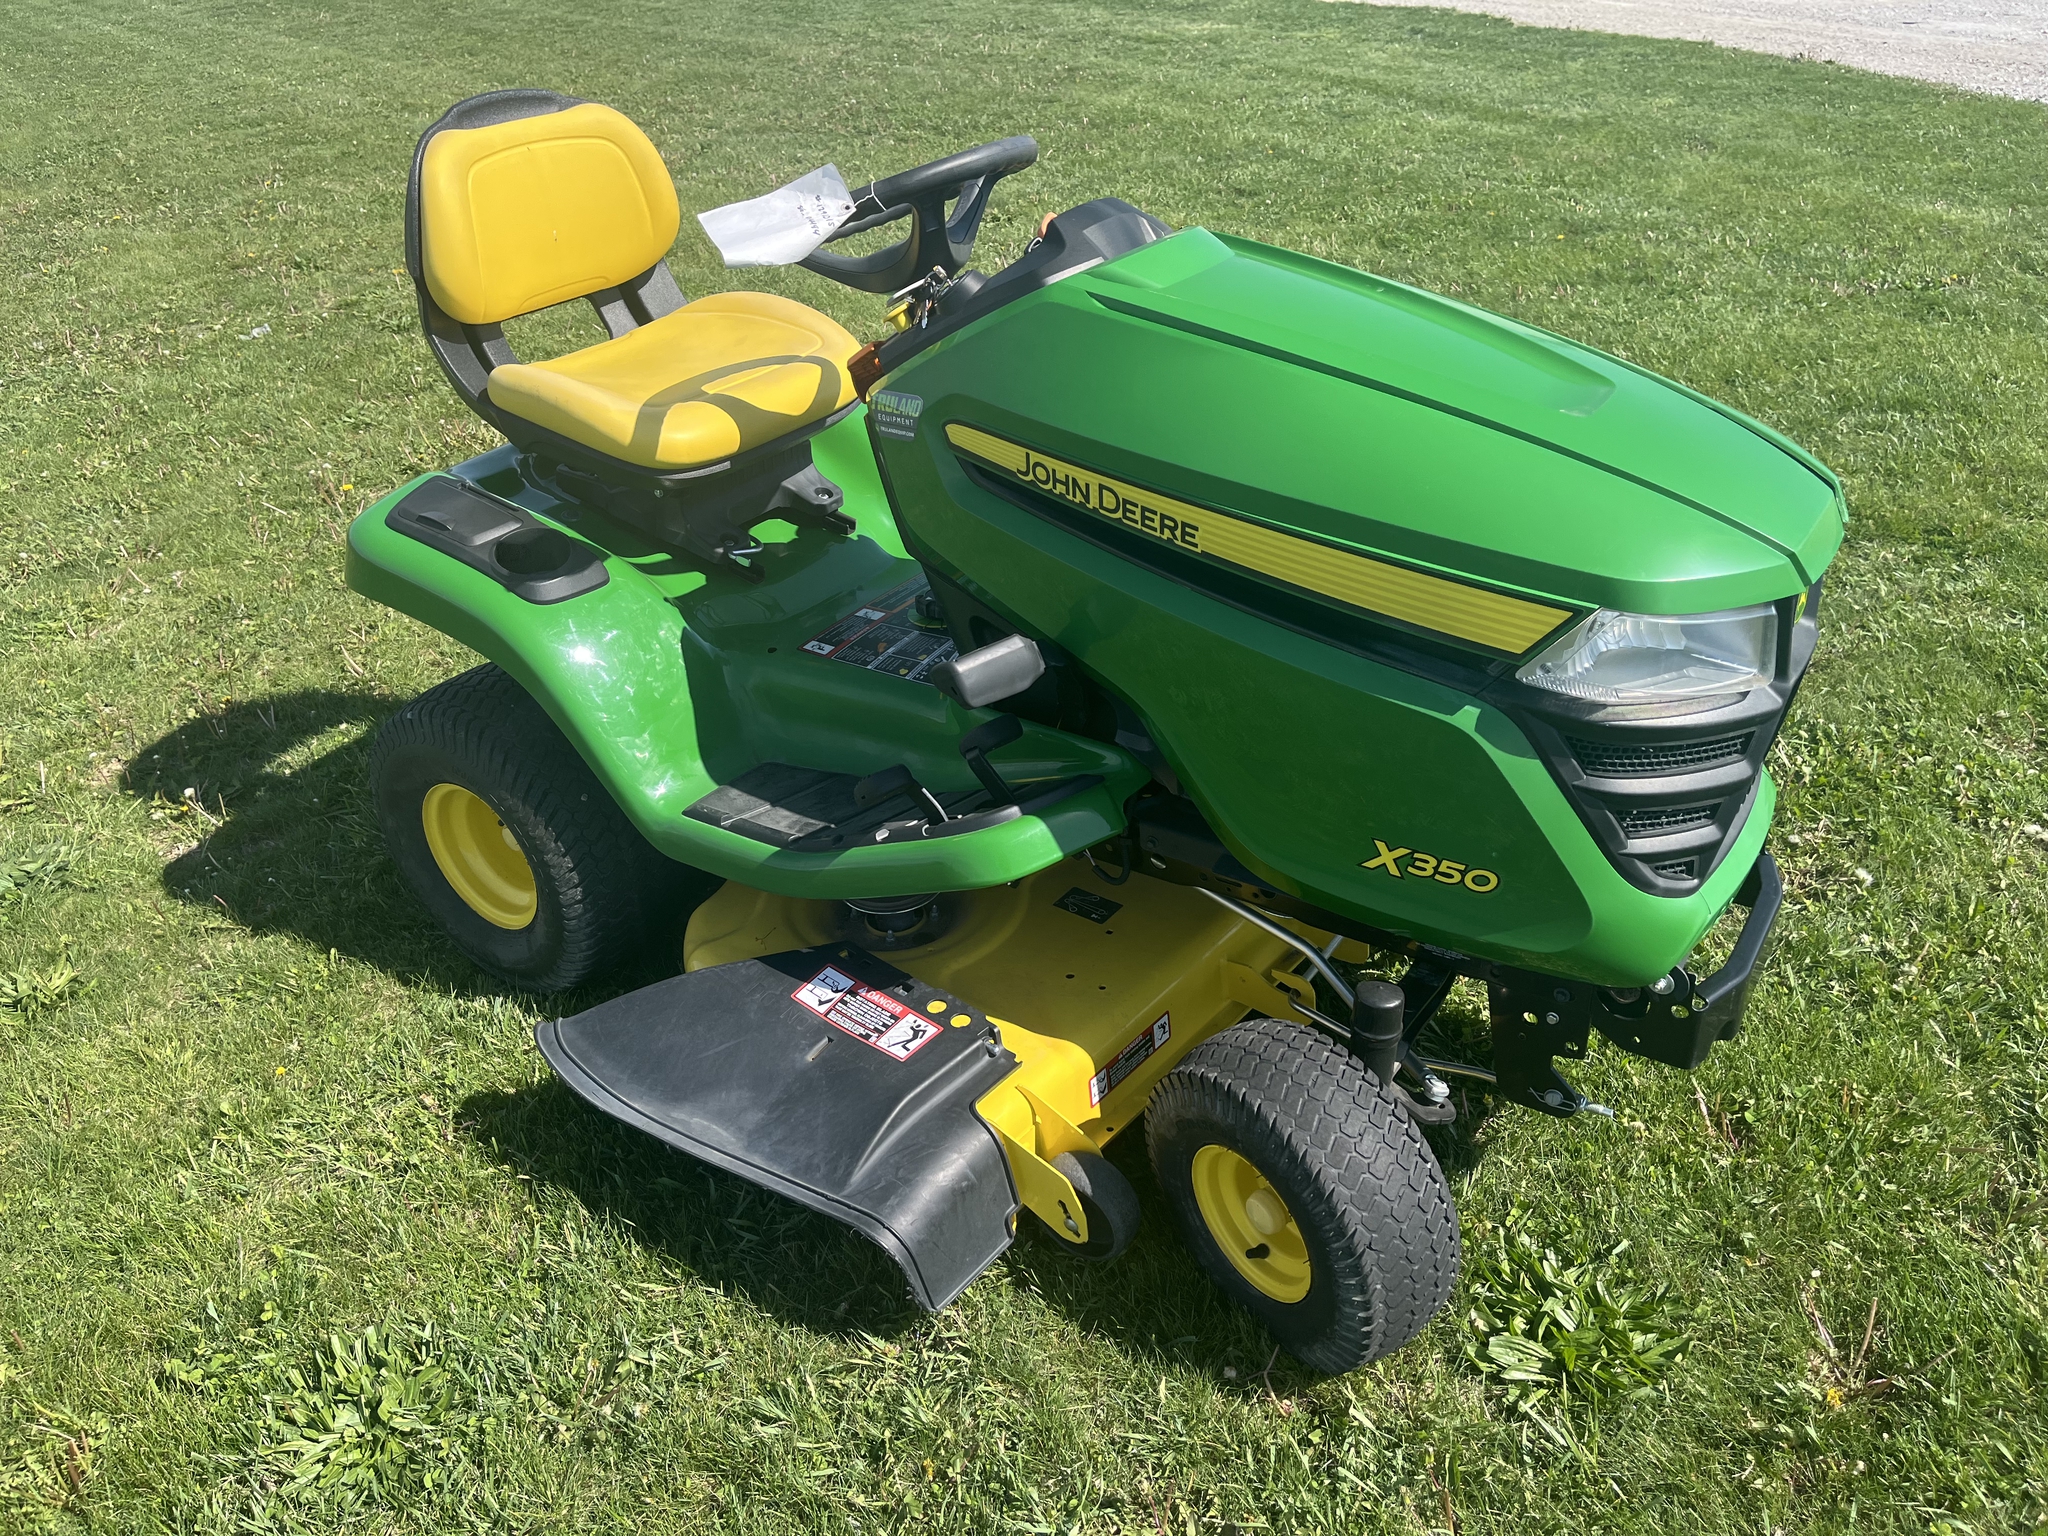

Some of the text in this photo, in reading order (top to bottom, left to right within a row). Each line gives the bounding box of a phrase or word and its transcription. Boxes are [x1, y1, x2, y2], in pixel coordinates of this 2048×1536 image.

[871, 393, 921, 417] TRULAND
[878, 413, 913, 426] EQUIPMENT
[1016, 451, 1200, 550] JOHN DEERE
[1360, 837, 1499, 893] X350
[866, 990, 904, 1014] DANGER
[1122, 1034, 1143, 1055] DANGER
